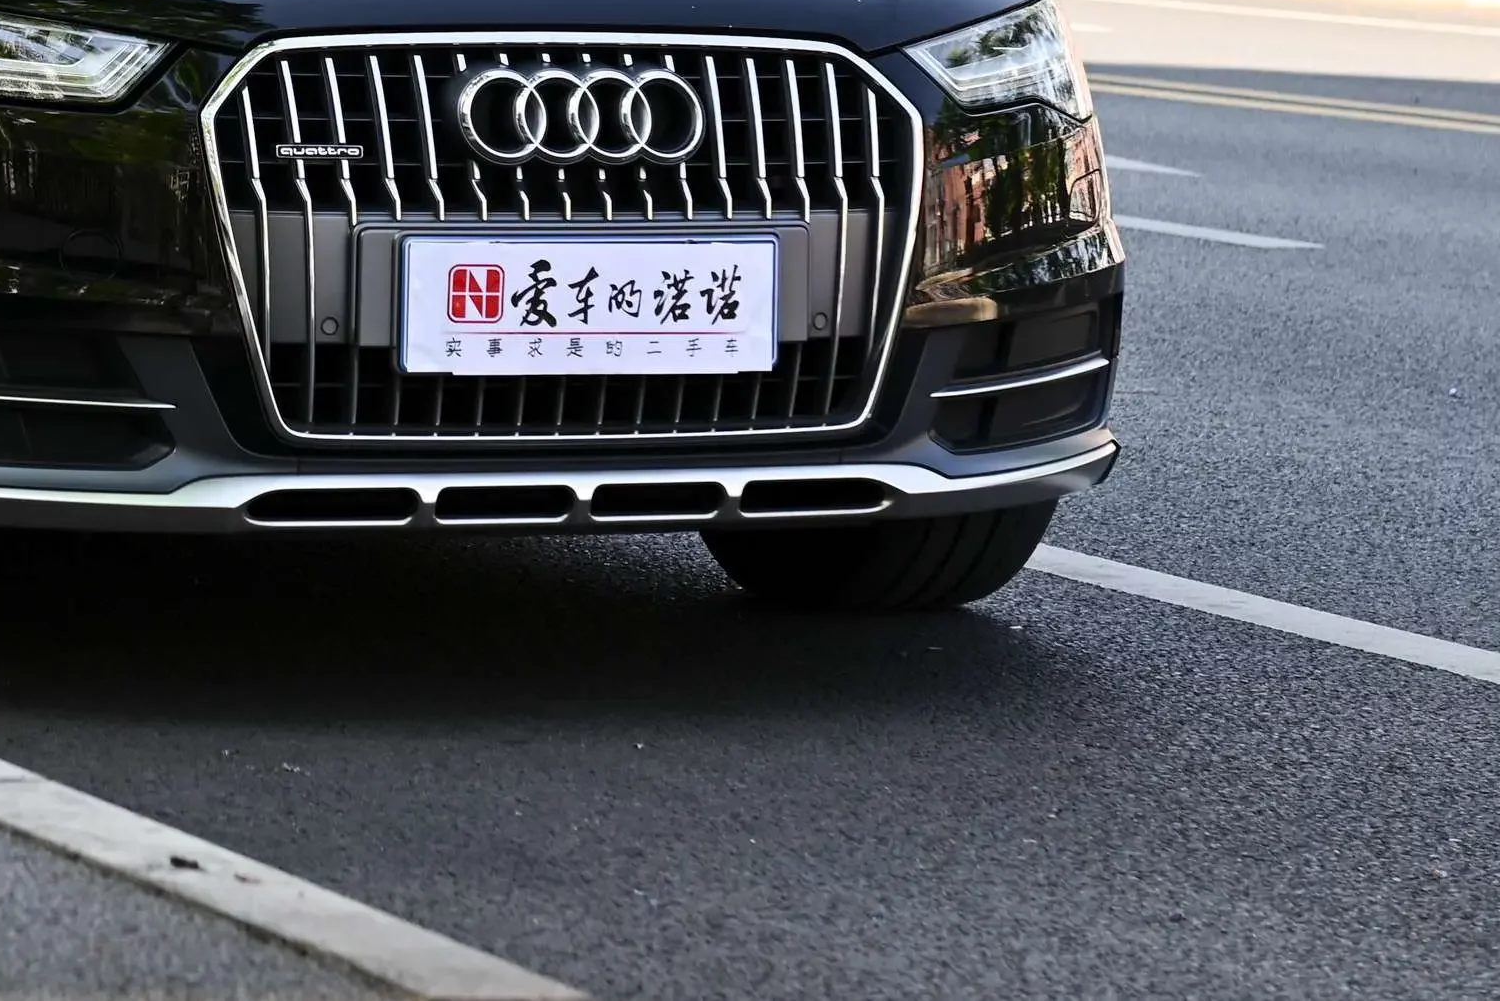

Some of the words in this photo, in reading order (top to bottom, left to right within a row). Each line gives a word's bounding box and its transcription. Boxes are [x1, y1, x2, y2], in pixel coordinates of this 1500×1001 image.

[280, 147, 360, 156] quattro
[445, 337, 739, 358] 实事求是的二手车
